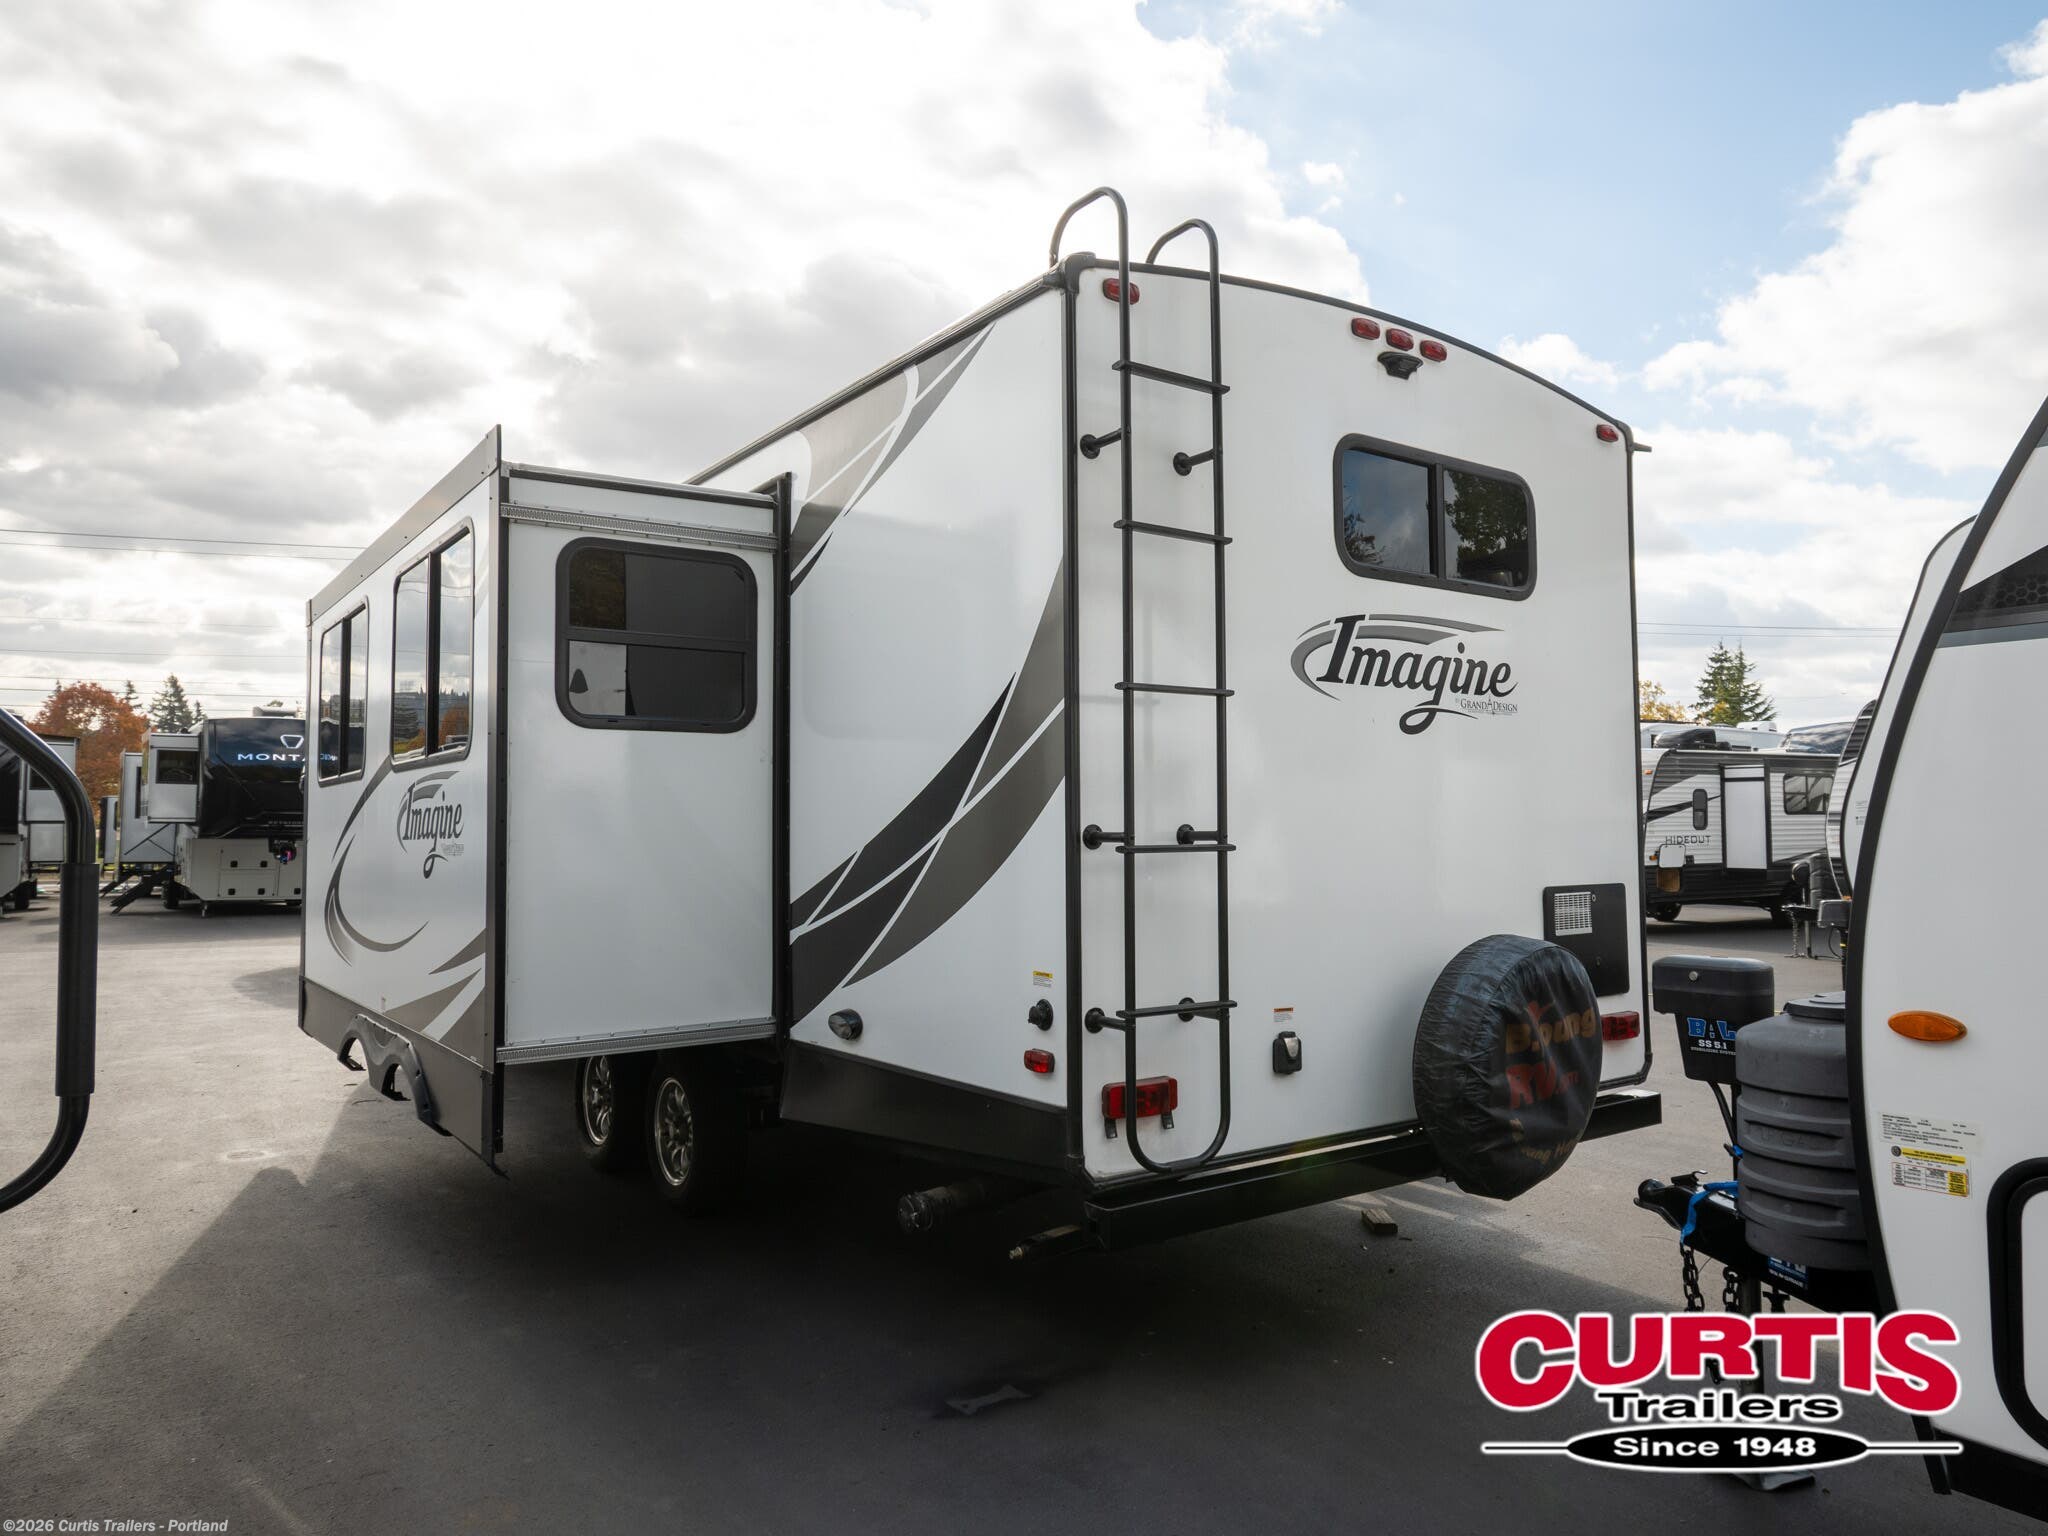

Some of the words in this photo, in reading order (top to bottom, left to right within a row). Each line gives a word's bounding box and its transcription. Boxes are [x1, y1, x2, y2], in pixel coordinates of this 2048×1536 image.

[1316, 614, 1519, 735] Imagine
[237, 753, 306, 762] MONT
[402, 782, 465, 879] Imagine
[1665, 835, 1712, 845] HIDEOUT
[1698, 1039, 1713, 1048] SS
